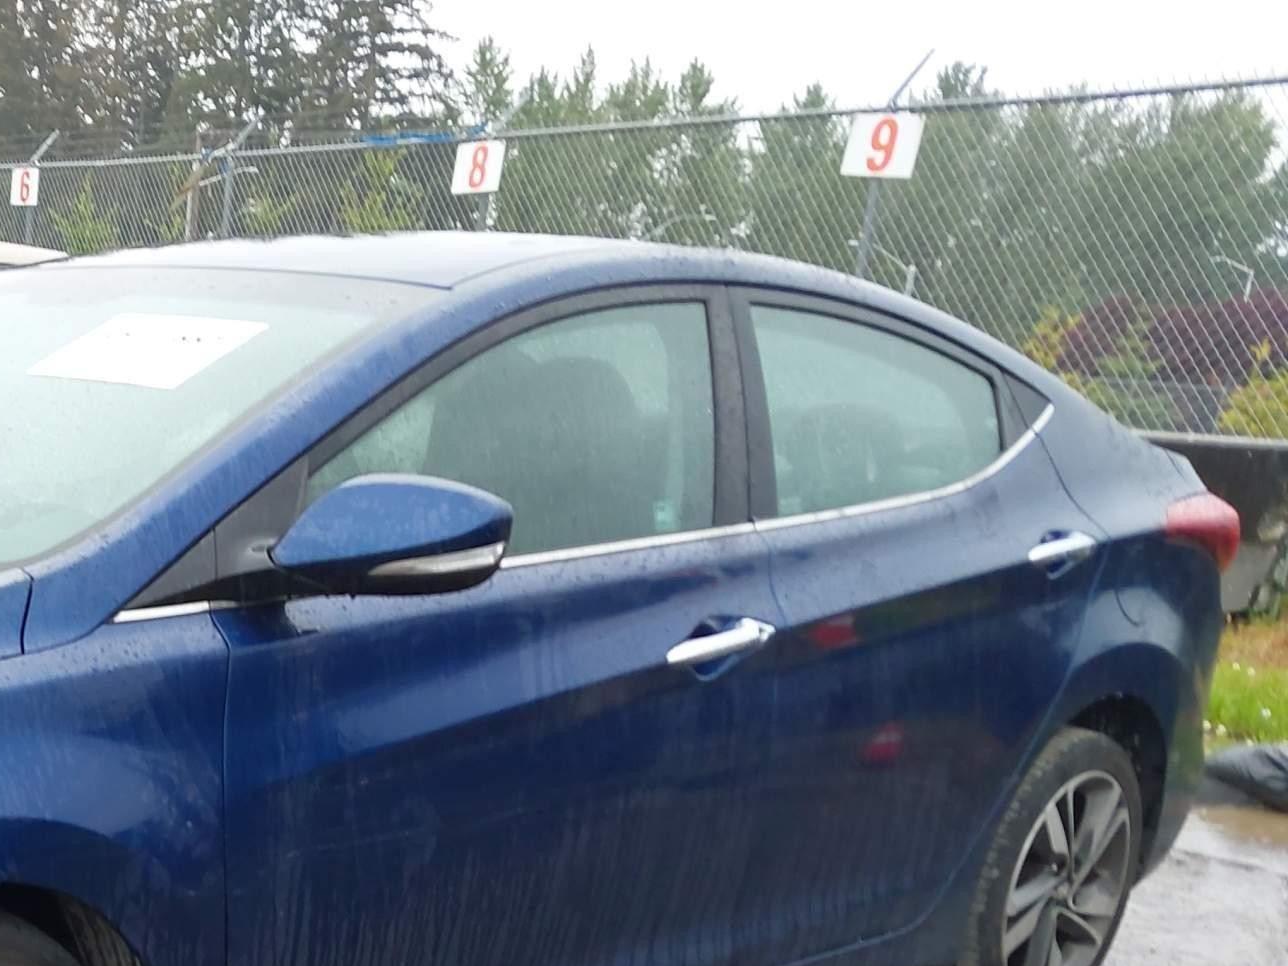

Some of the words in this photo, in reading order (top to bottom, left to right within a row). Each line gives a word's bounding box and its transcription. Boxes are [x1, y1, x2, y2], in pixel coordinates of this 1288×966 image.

[865, 116, 899, 173] 9
[19, 170, 31, 203] 6
[468, 145, 489, 189] 8
